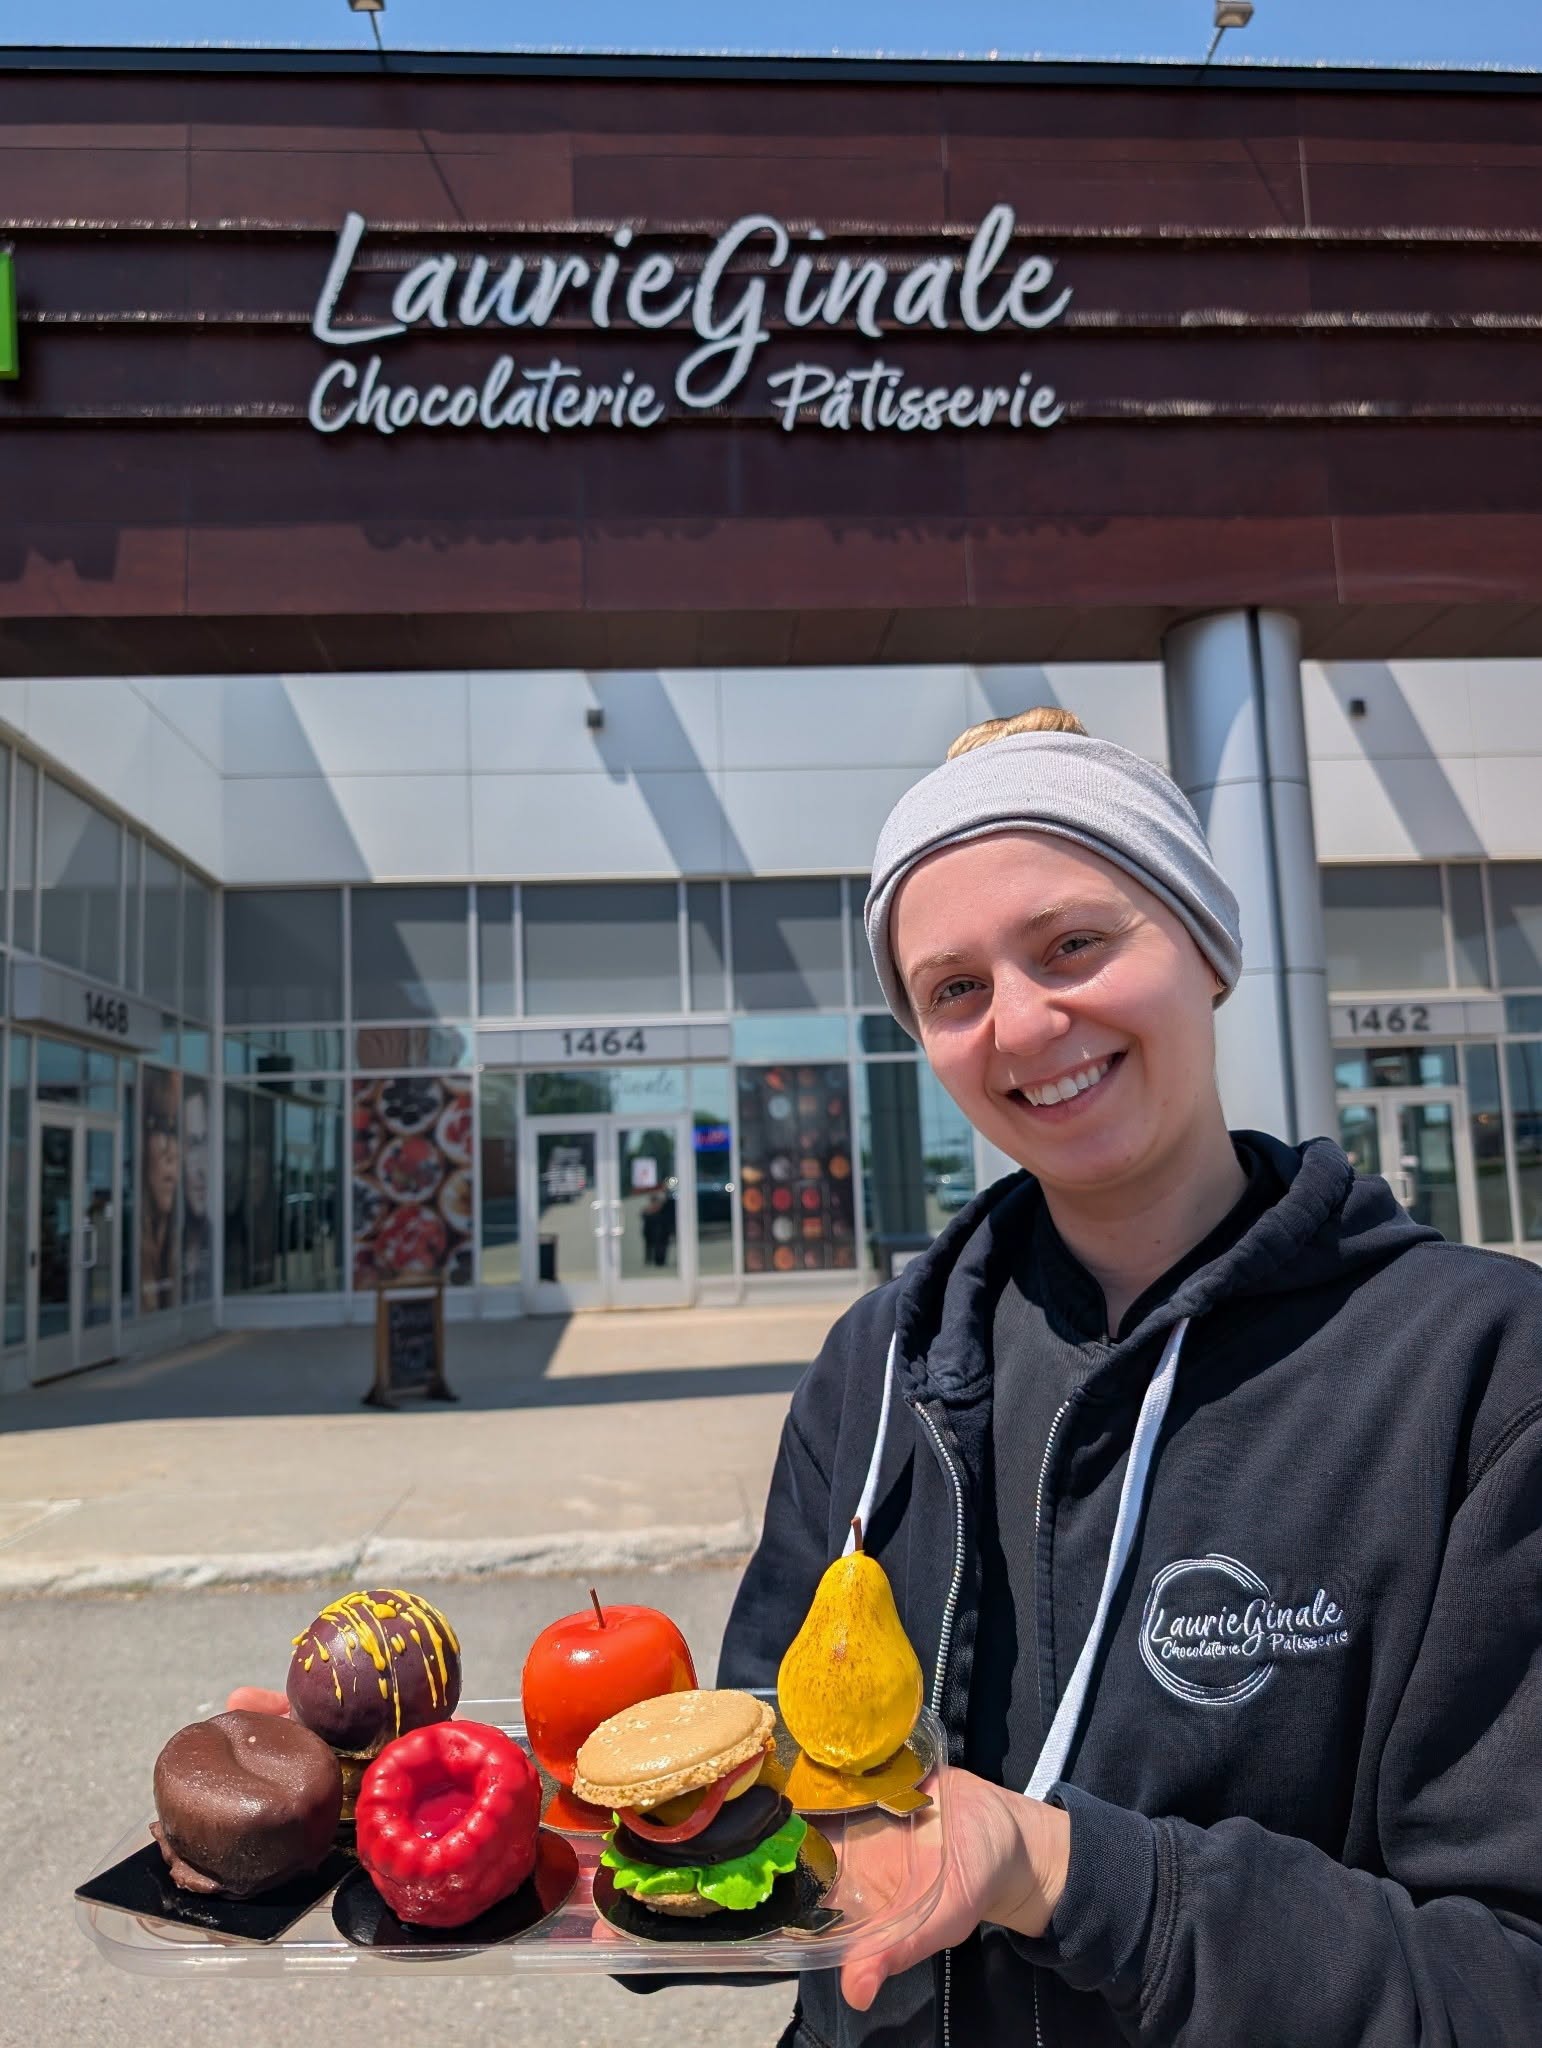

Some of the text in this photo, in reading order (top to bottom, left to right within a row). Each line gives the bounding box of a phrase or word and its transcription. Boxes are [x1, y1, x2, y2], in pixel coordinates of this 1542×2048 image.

[312, 204, 1073, 406] LaurieGinale
[309, 356, 1066, 433] Chocolaterie Pâtisserie
[85, 991, 128, 1034] 1468
[1347, 1005, 1431, 1034] 1462
[563, 1027, 647, 1057] 1464
[1151, 1588, 1343, 1656] LaurieGinale
[1161, 1639, 1240, 1660] Chocolaterie
